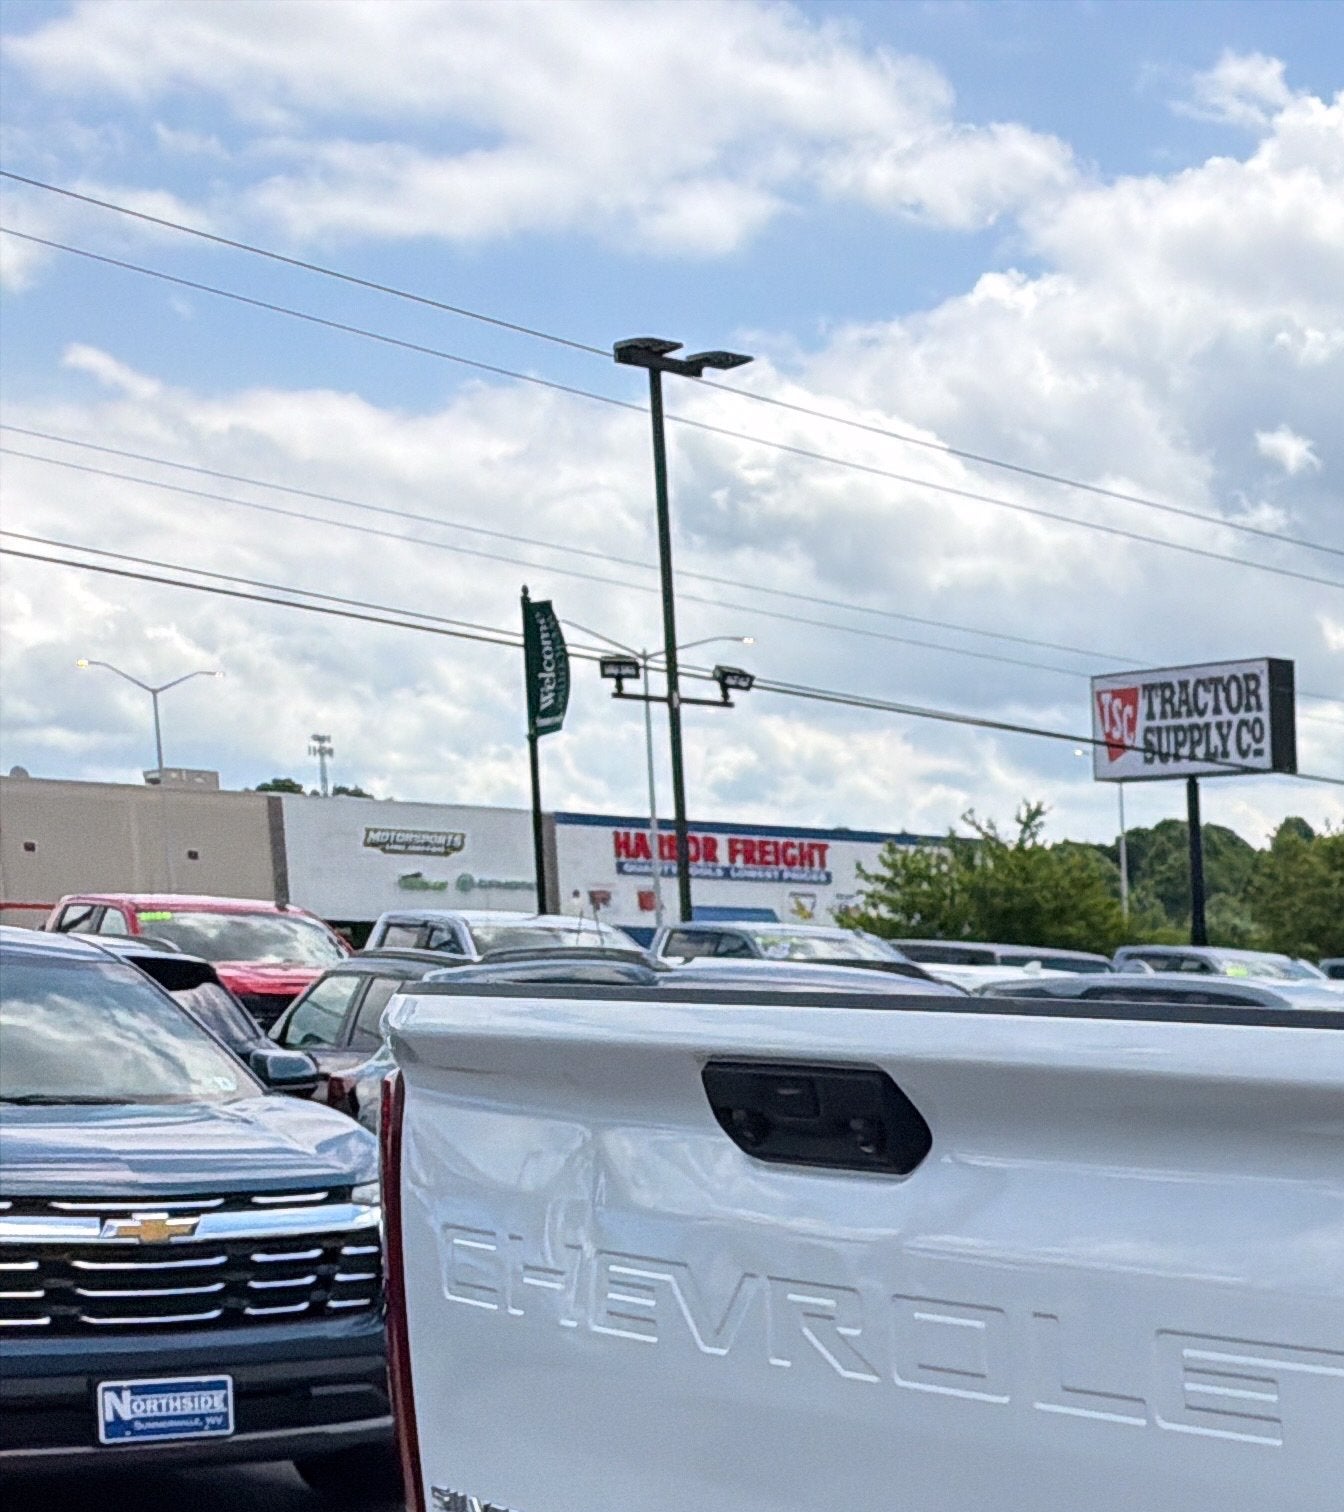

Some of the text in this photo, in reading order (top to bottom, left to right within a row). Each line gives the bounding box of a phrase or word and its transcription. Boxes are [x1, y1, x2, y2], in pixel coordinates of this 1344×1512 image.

[1100, 692, 1135, 742] TSC
[1142, 672, 1264, 722] TRACTOR
[1143, 718, 1235, 765] SUPPLY
[728, 837, 831, 869] FREIGHT
